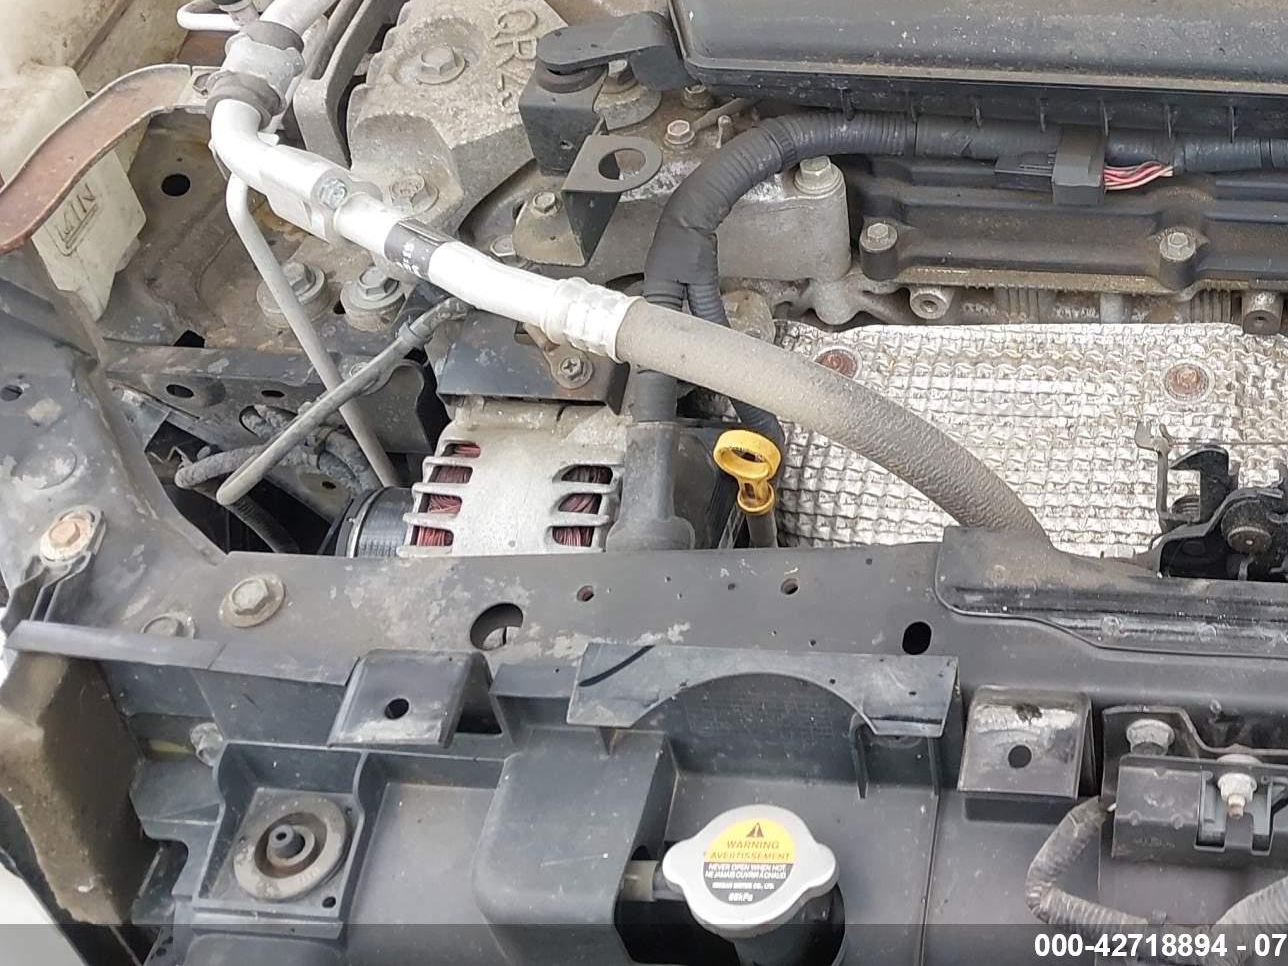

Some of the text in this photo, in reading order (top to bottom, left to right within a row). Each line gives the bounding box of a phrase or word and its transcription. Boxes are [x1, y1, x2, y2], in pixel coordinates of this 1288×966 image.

[727, 840, 779, 850] WARNING
[710, 851, 790, 861] AVERTISSEMENT
[708, 863, 731, 871] NEVER
[750, 864, 772, 872] WHEN
[772, 864, 787, 872] HOT
